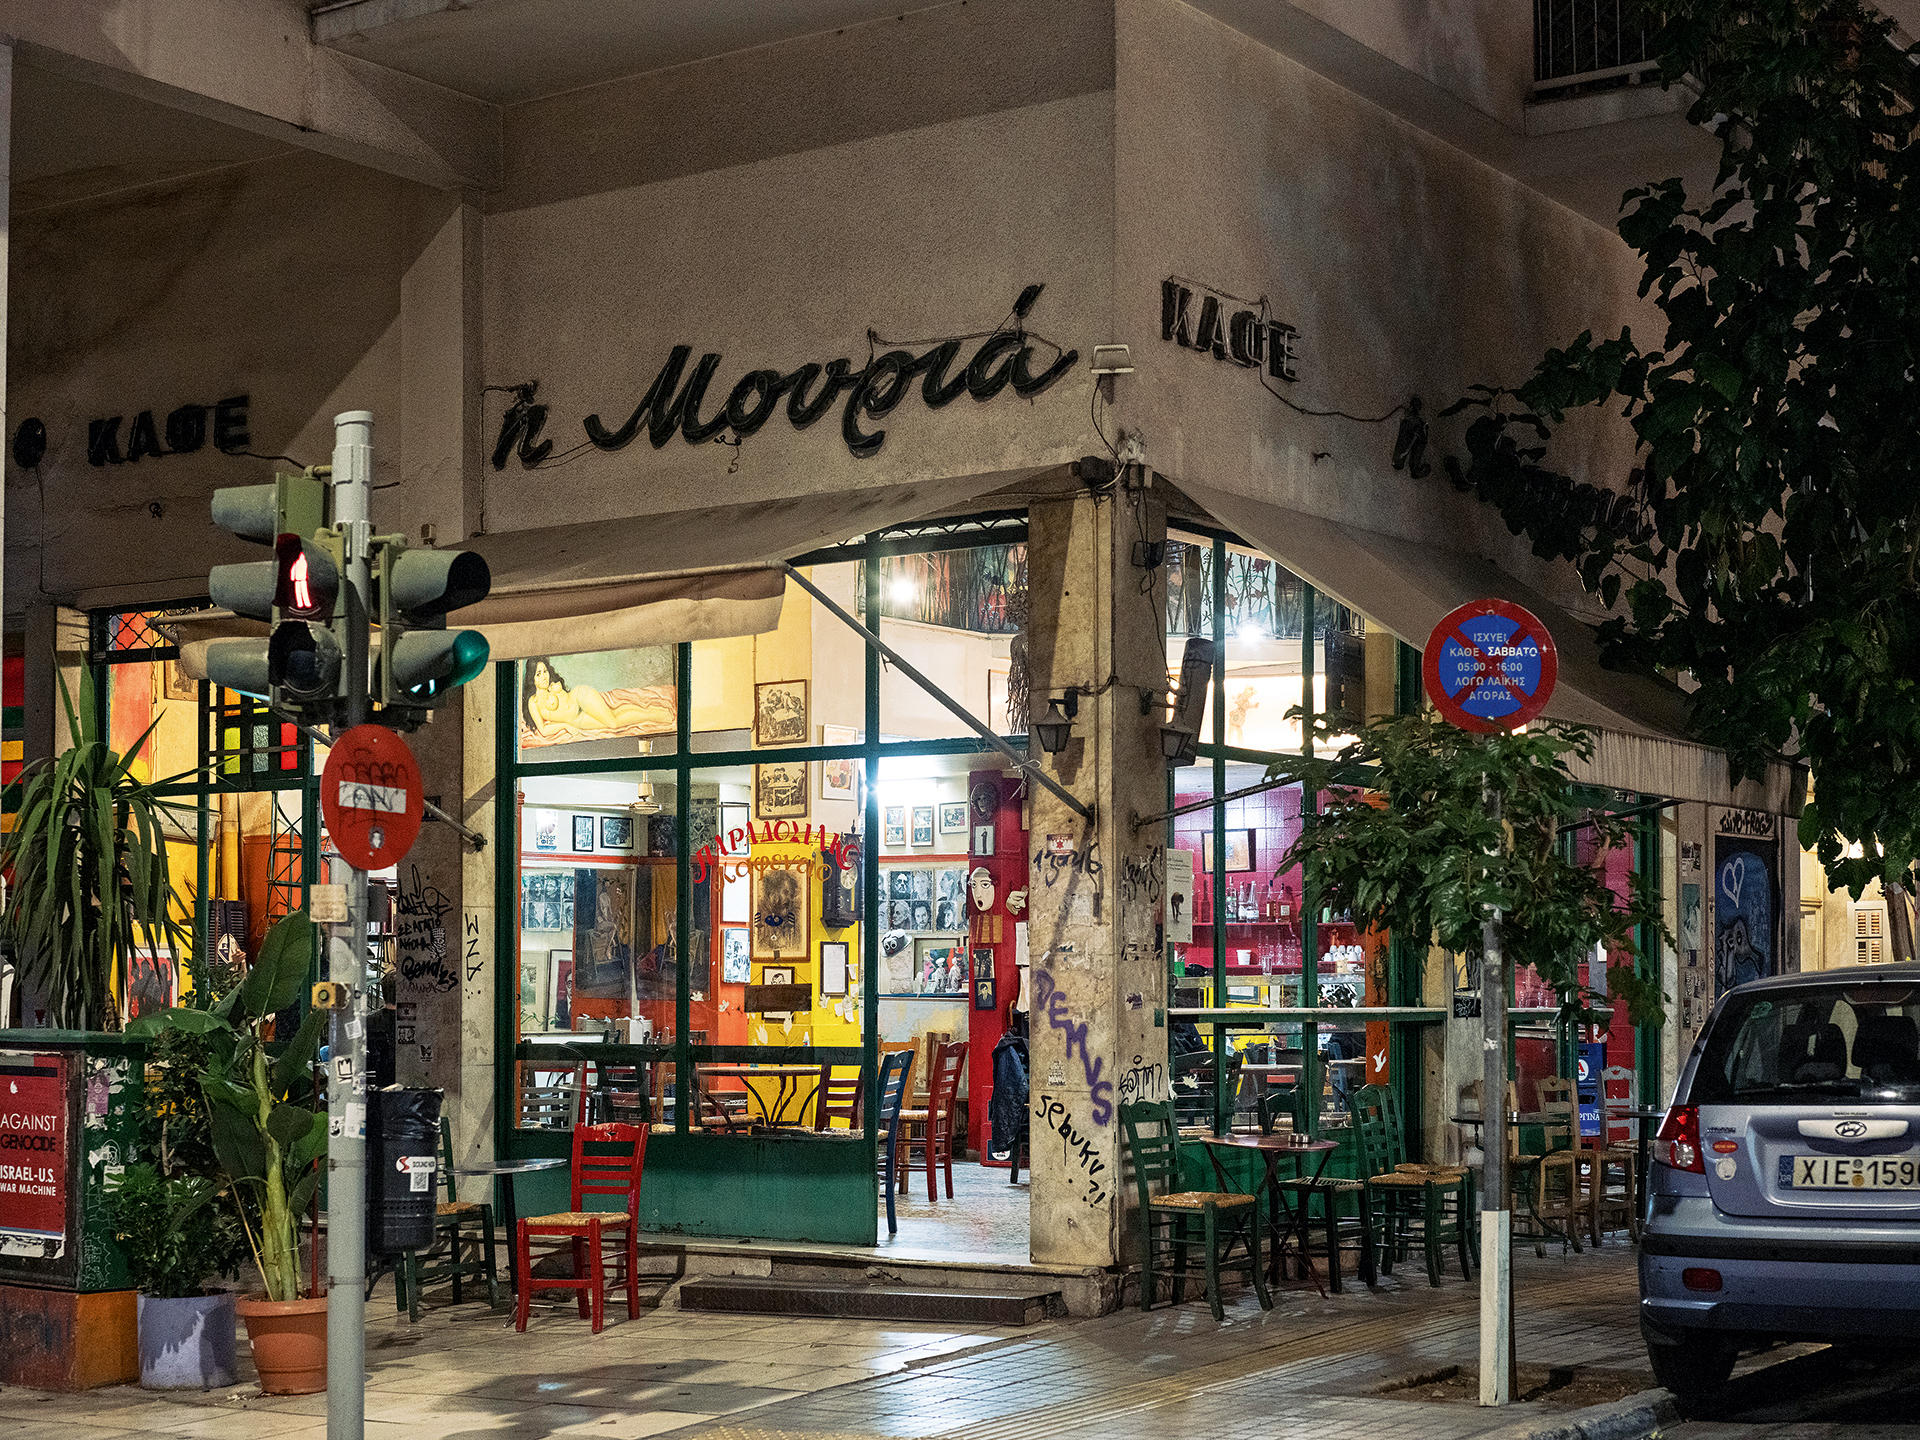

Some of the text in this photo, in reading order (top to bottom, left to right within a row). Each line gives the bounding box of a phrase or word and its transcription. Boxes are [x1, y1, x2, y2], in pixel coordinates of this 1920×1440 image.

[1473, 632, 1507, 643] ΙΣΧΥΕΙ
[1449, 646, 1538, 657] ΚΑΘΕ ΣΑΒΒΑΤΟ
[1457, 662, 1486, 672] 05:00
[1496, 662, 1523, 672] 16:00
[1455, 676, 1485, 686] ΛΟΓΩ
[1469, 691, 1512, 701] ΑΓΟΡΑΣ
[0, 1113, 57, 1131] AGAINST
[1, 1133, 56, 1152] GENOCIDE
[0, 1164, 56, 1184] ISRAEL-U.S.
[0, 1182, 57, 1197] WAR MACHINE
